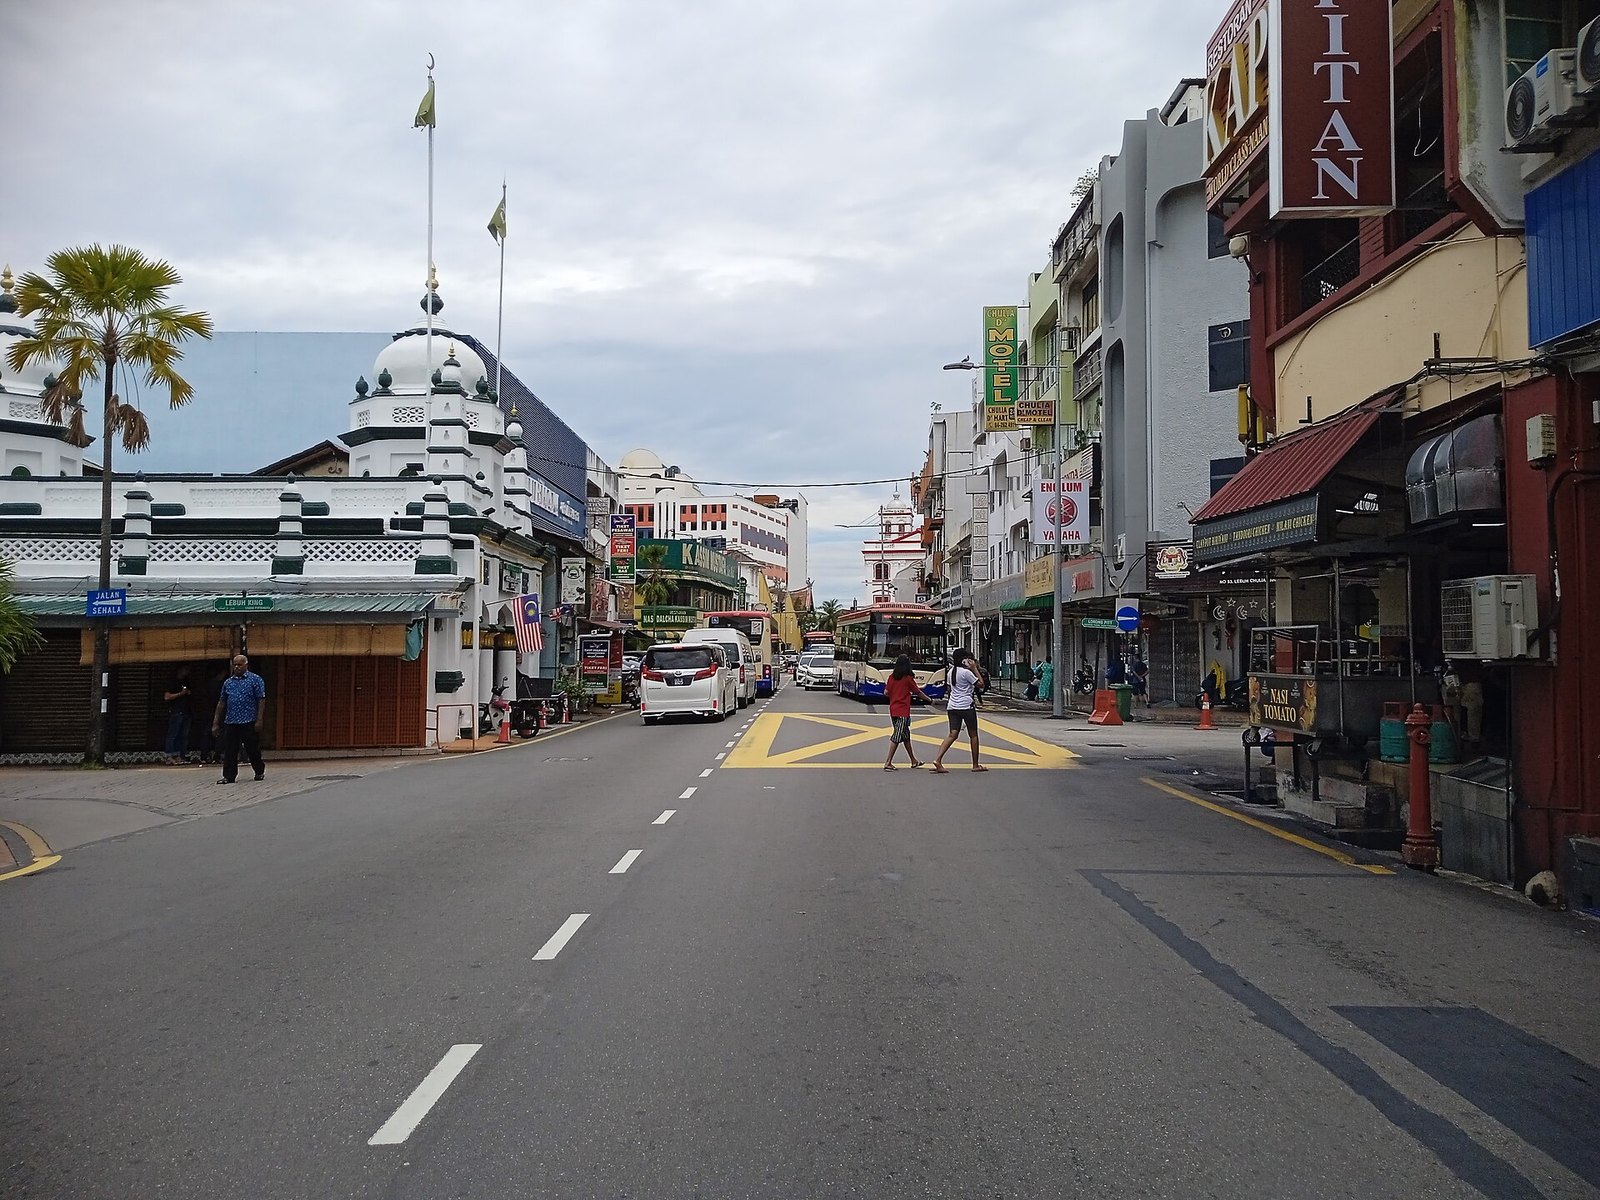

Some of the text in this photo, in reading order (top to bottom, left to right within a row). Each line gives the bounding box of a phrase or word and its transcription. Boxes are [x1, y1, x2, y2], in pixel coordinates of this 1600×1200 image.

[1207, 0, 1252, 75] RESTORAN
[1312, 0, 1363, 199] ITAN
[1208, 116, 1268, 199] WORLD CLASS NAAN
[987, 309, 1014, 318] CHULIA
[988, 328, 1014, 402] MOTEL
[1043, 531, 1080, 540] YAAHA
[92, 606, 121, 614] SEHALA
[1270, 688, 1288, 705] NASI
[1263, 704, 1296, 723] TOMATO
